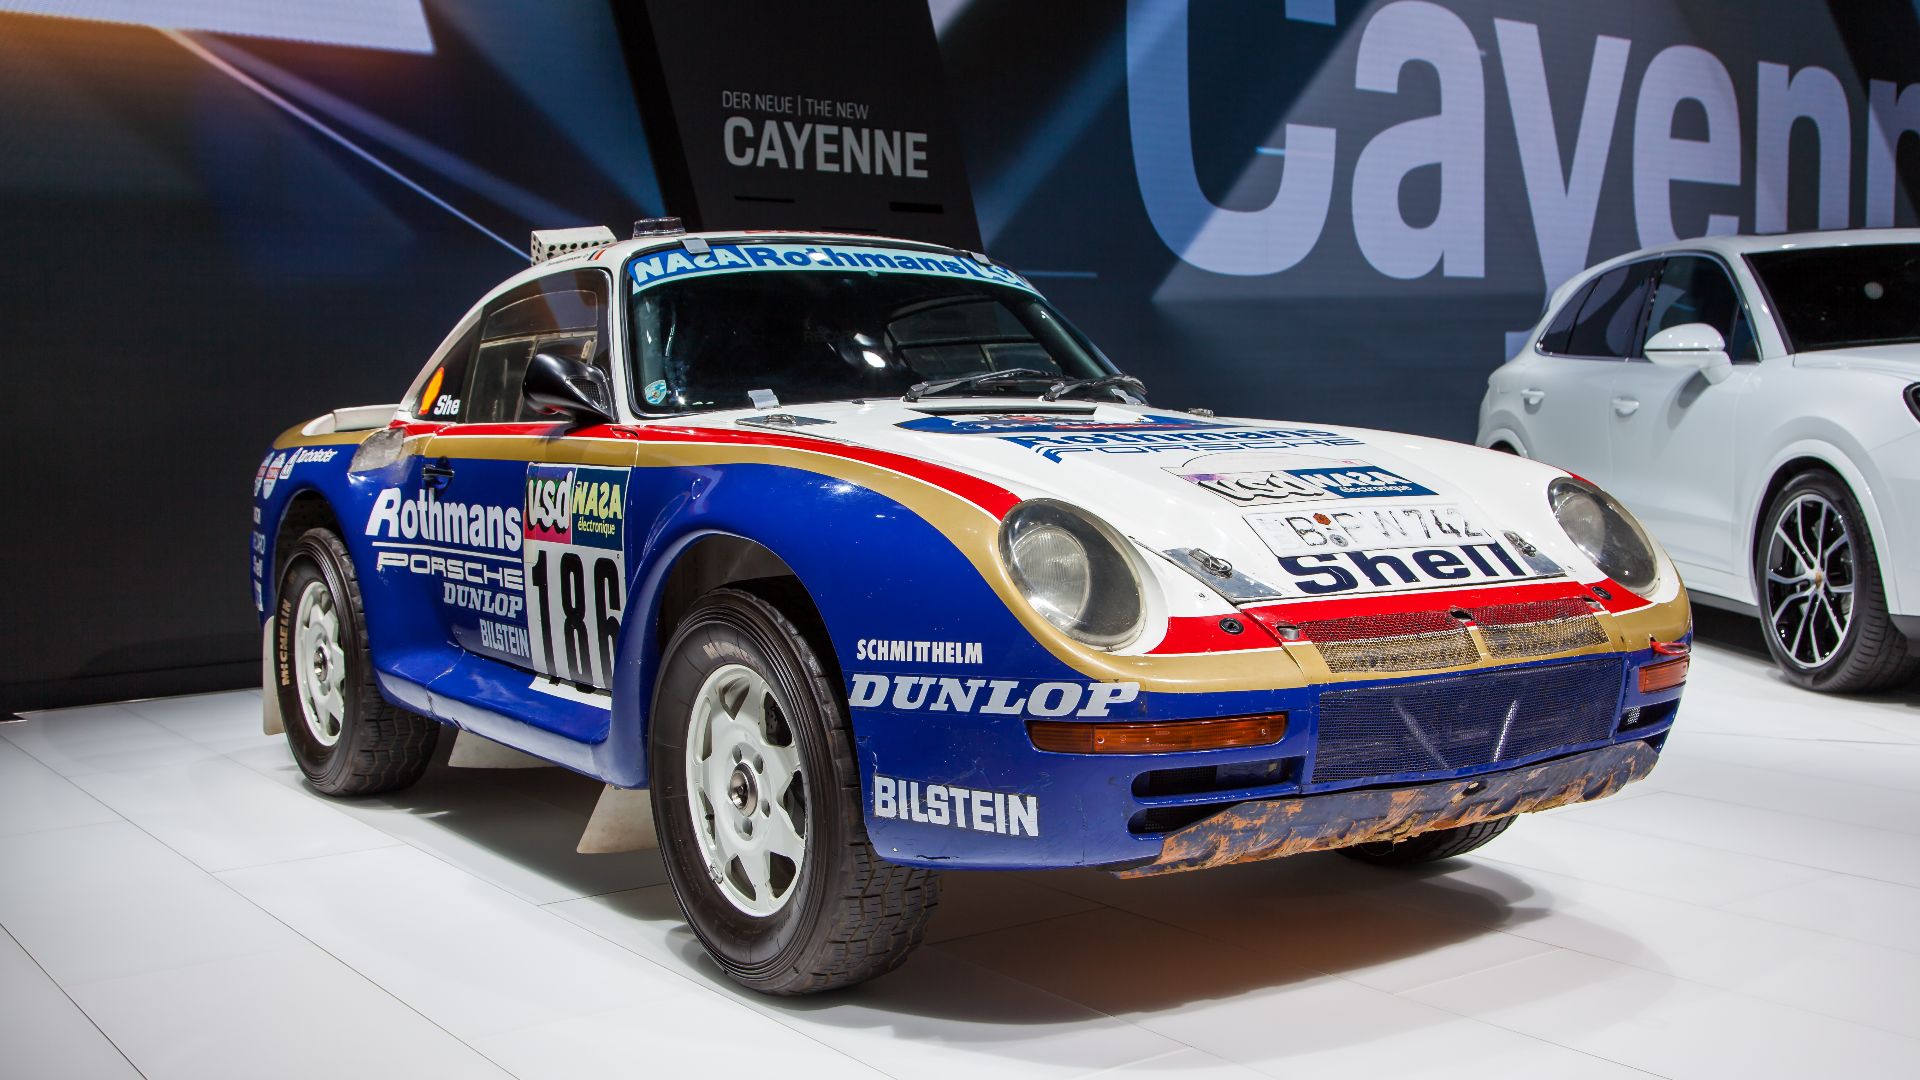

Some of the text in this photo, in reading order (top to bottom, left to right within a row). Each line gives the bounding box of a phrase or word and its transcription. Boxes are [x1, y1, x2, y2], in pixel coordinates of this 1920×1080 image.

[722, 90, 869, 120] DER NEUE THE NEW
[724, 116, 928, 178] CAYENNE
[743, 247, 967, 275] Rothmans
[995, 429, 1340, 449] Rothmans
[1035, 438, 1367, 463] PORSCHE
[365, 487, 522, 552] Rothmans
[573, 480, 623, 520] NASA
[376, 551, 524, 591] PORSCHE
[1278, 541, 1527, 595] Shell
[443, 582, 523, 619] DUNLOP
[480, 618, 531, 658] BILSTEIN
[532, 549, 622, 693] 186
[856, 638, 983, 664] SCHMITTHELM
[848, 673, 1141, 718] DUNLOP
[874, 775, 1039, 838] BILSTEIN
